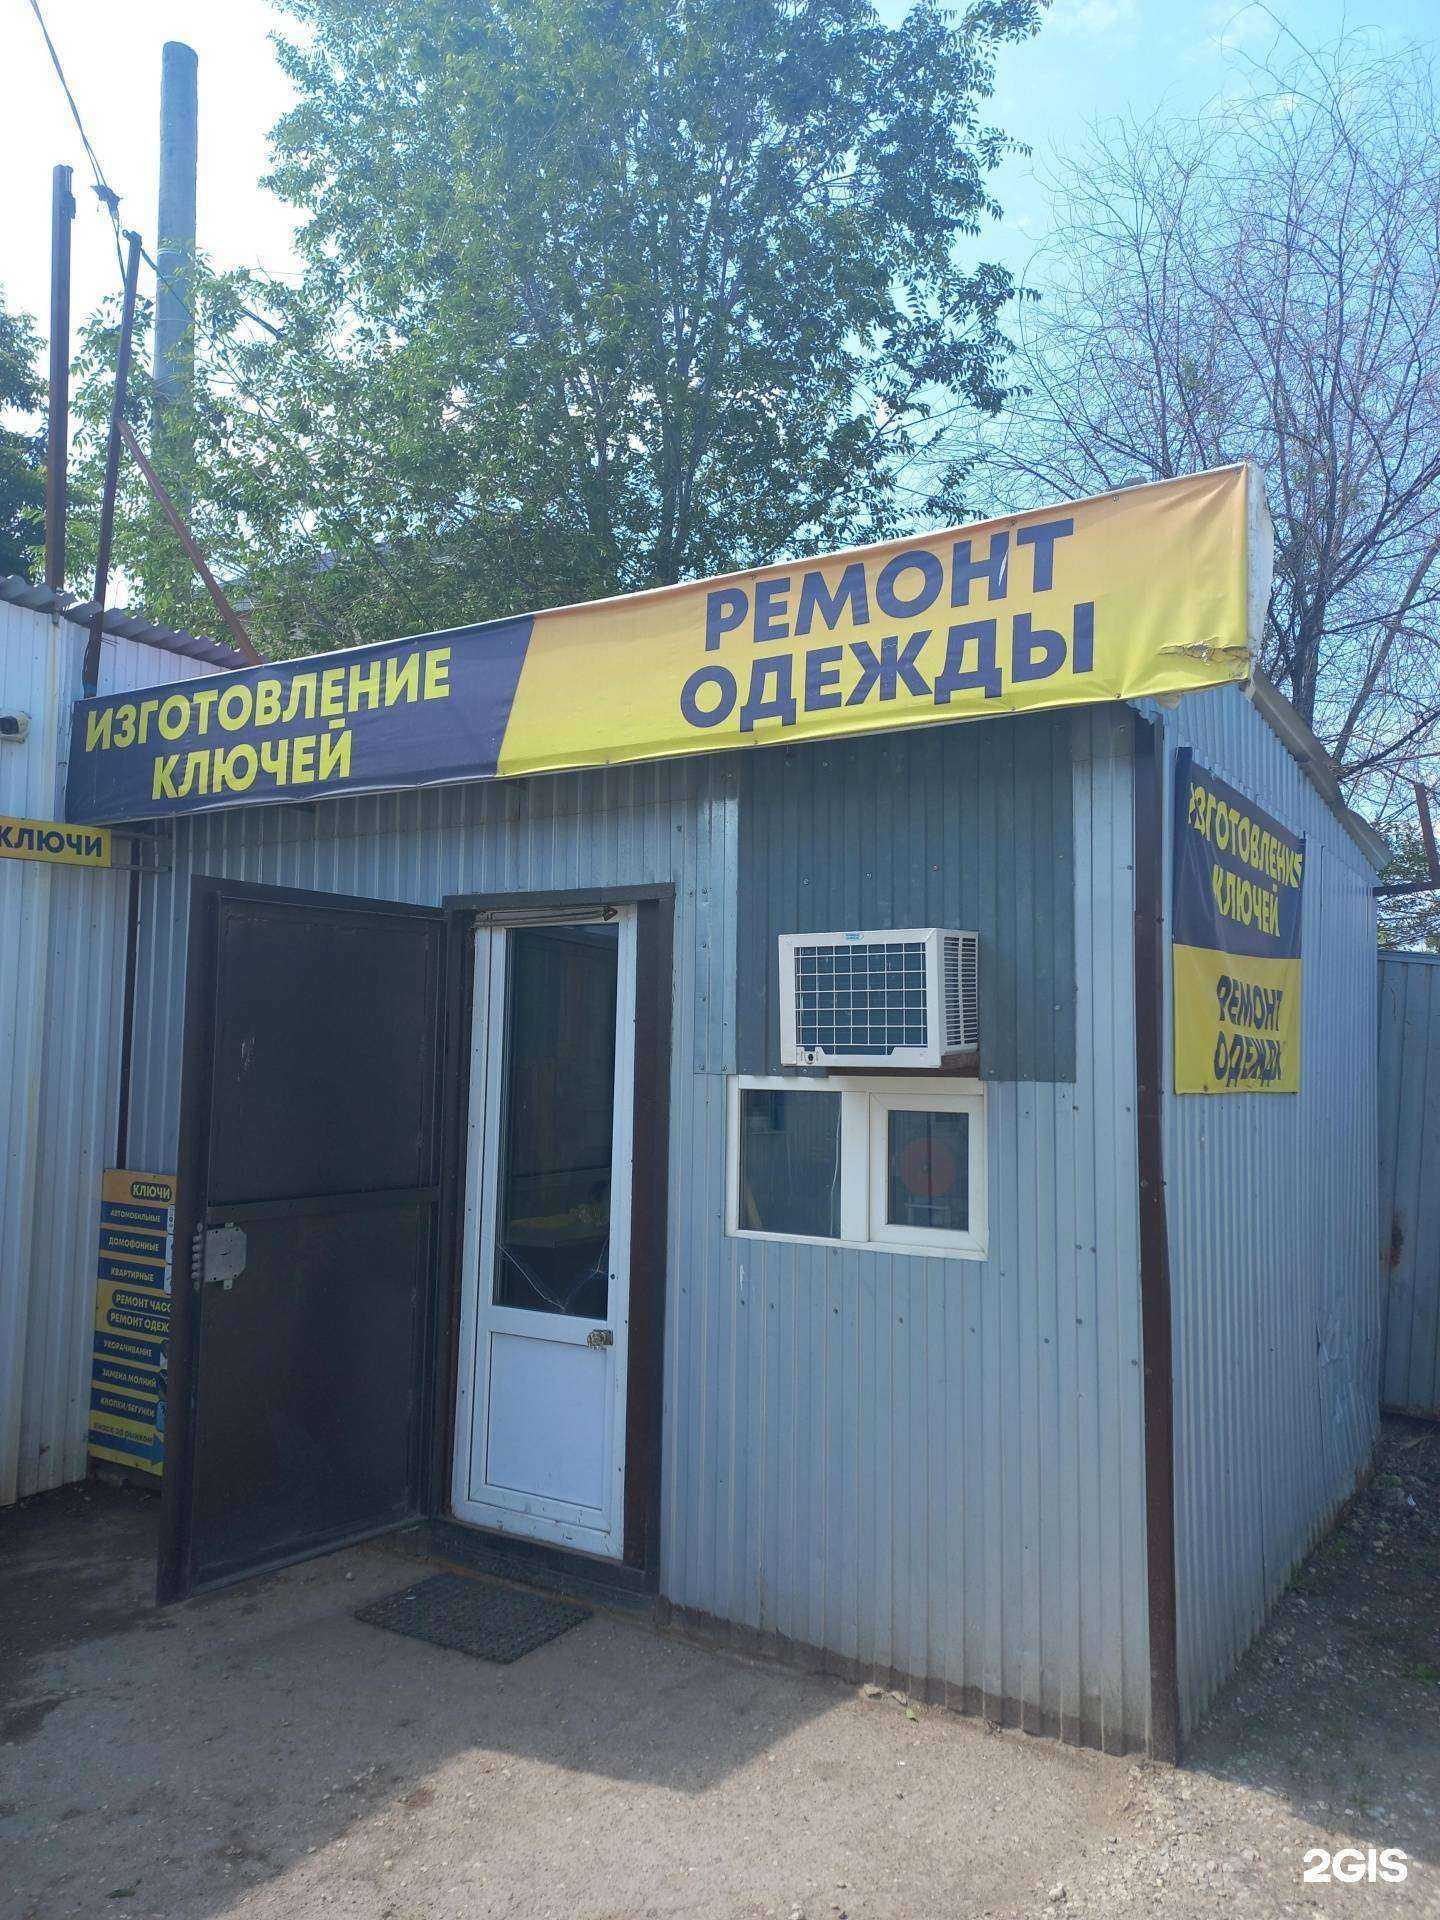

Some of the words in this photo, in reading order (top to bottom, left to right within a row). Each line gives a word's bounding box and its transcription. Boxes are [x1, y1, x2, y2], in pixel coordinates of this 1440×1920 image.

[705, 518, 1074, 652] РЕМОНТ
[680, 601, 1095, 733] ОДЕЖДЫ
[85, 647, 452, 752] ИЗГОТОВЛЕНИЕ
[151, 716, 353, 800] КЛЮЧЕЙ
[0, 825, 102, 857] КЛЮЧИ
[1212, 864, 1280, 938] КЛЮЧЕЙ
[1216, 974, 1284, 1032] РЕМОНТ
[132, 1184, 170, 1199] КЛЮЧИ
[108, 1236, 159, 1252] ДОМОФОННЫЕ
[110, 1266, 155, 1282] КВАРТИРНЫЕ
[110, 1312, 144, 1328] РЕМОНТ
[115, 1294, 149, 1309] РЕМОНТ
